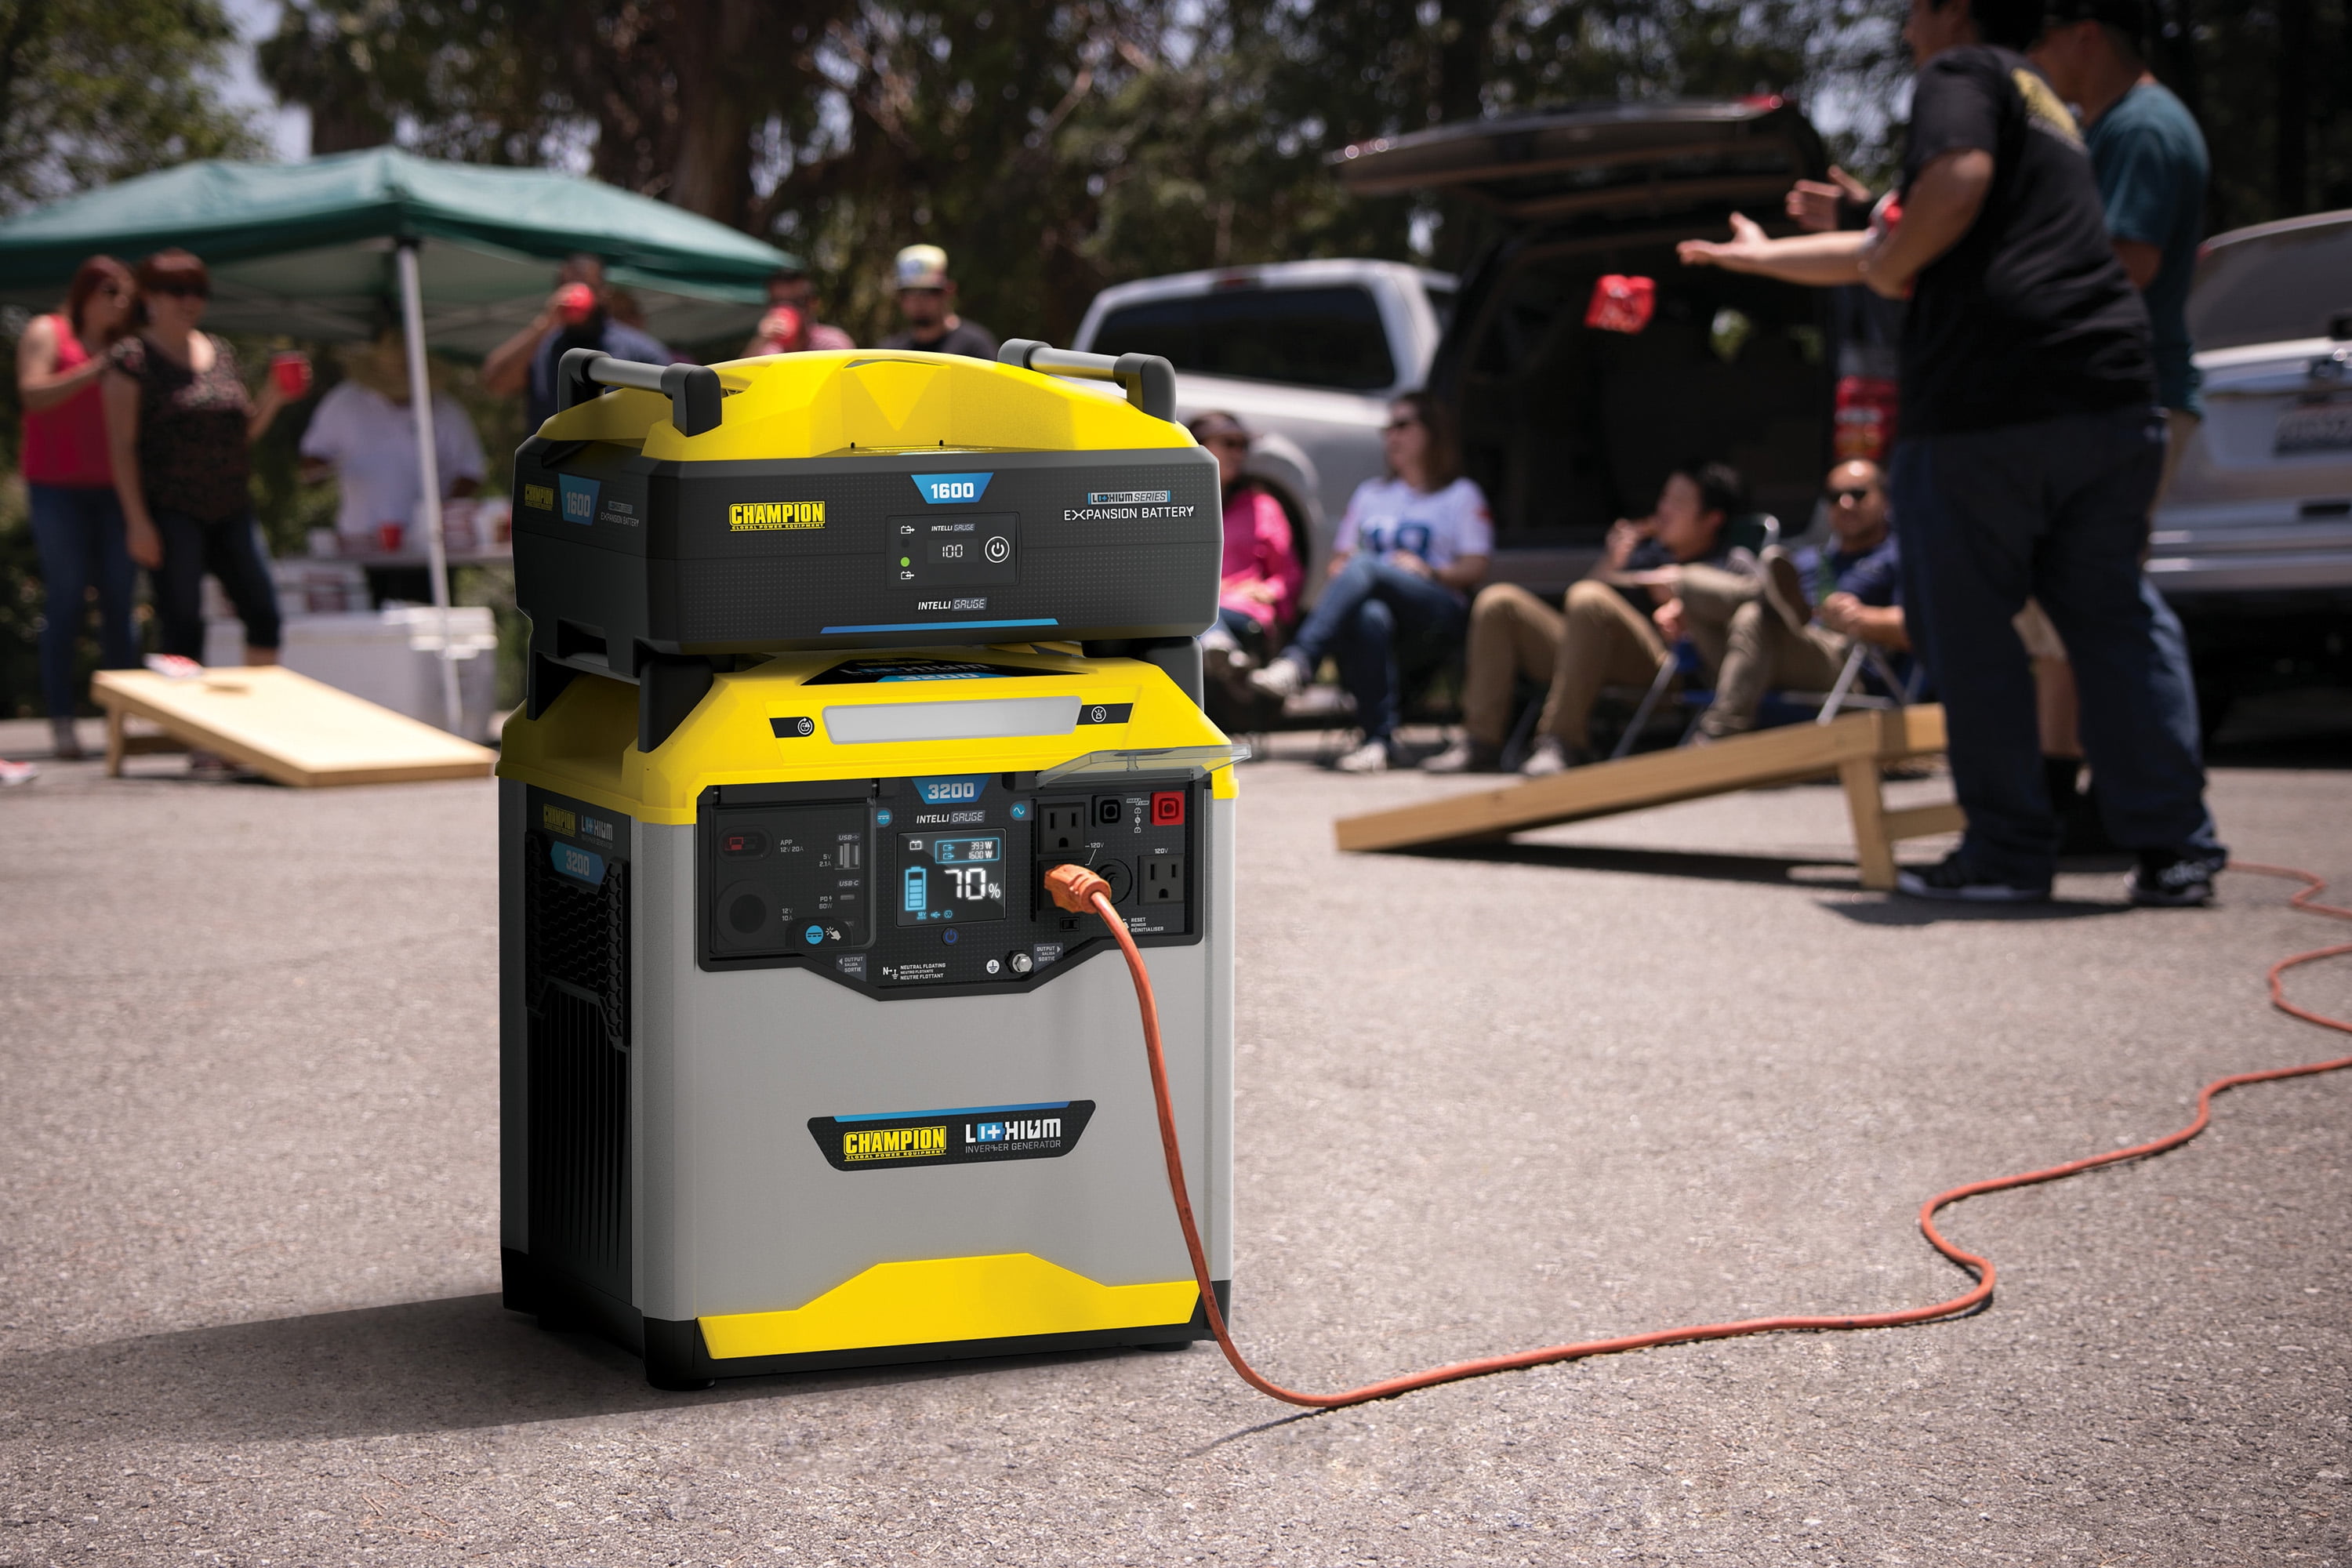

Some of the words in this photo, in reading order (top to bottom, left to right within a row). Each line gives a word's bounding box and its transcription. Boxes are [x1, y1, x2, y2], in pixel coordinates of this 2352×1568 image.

[931, 483, 974, 499] 1600
[1134, 492, 1166, 501] SERIES
[567, 492, 590, 517] 1600
[731, 503, 823, 524] CHAMPION
[1064, 508, 1137, 521] EXPANSION
[1142, 506, 1194, 518] BATTERY
[942, 544, 964, 558] 100
[918, 601, 952, 610] INTELLI
[953, 599, 985, 609] GAUGE
[927, 782, 975, 800] 3200
[916, 814, 949, 824] INTELLI
[952, 811, 983, 822] GAUGE
[985, 840, 993, 849] W
[985, 850, 993, 859] W
[566, 850, 590, 877] 3200
[845, 1128, 945, 1154] CHAMPION
[1011, 1140, 1061, 1151] GENERATOR
